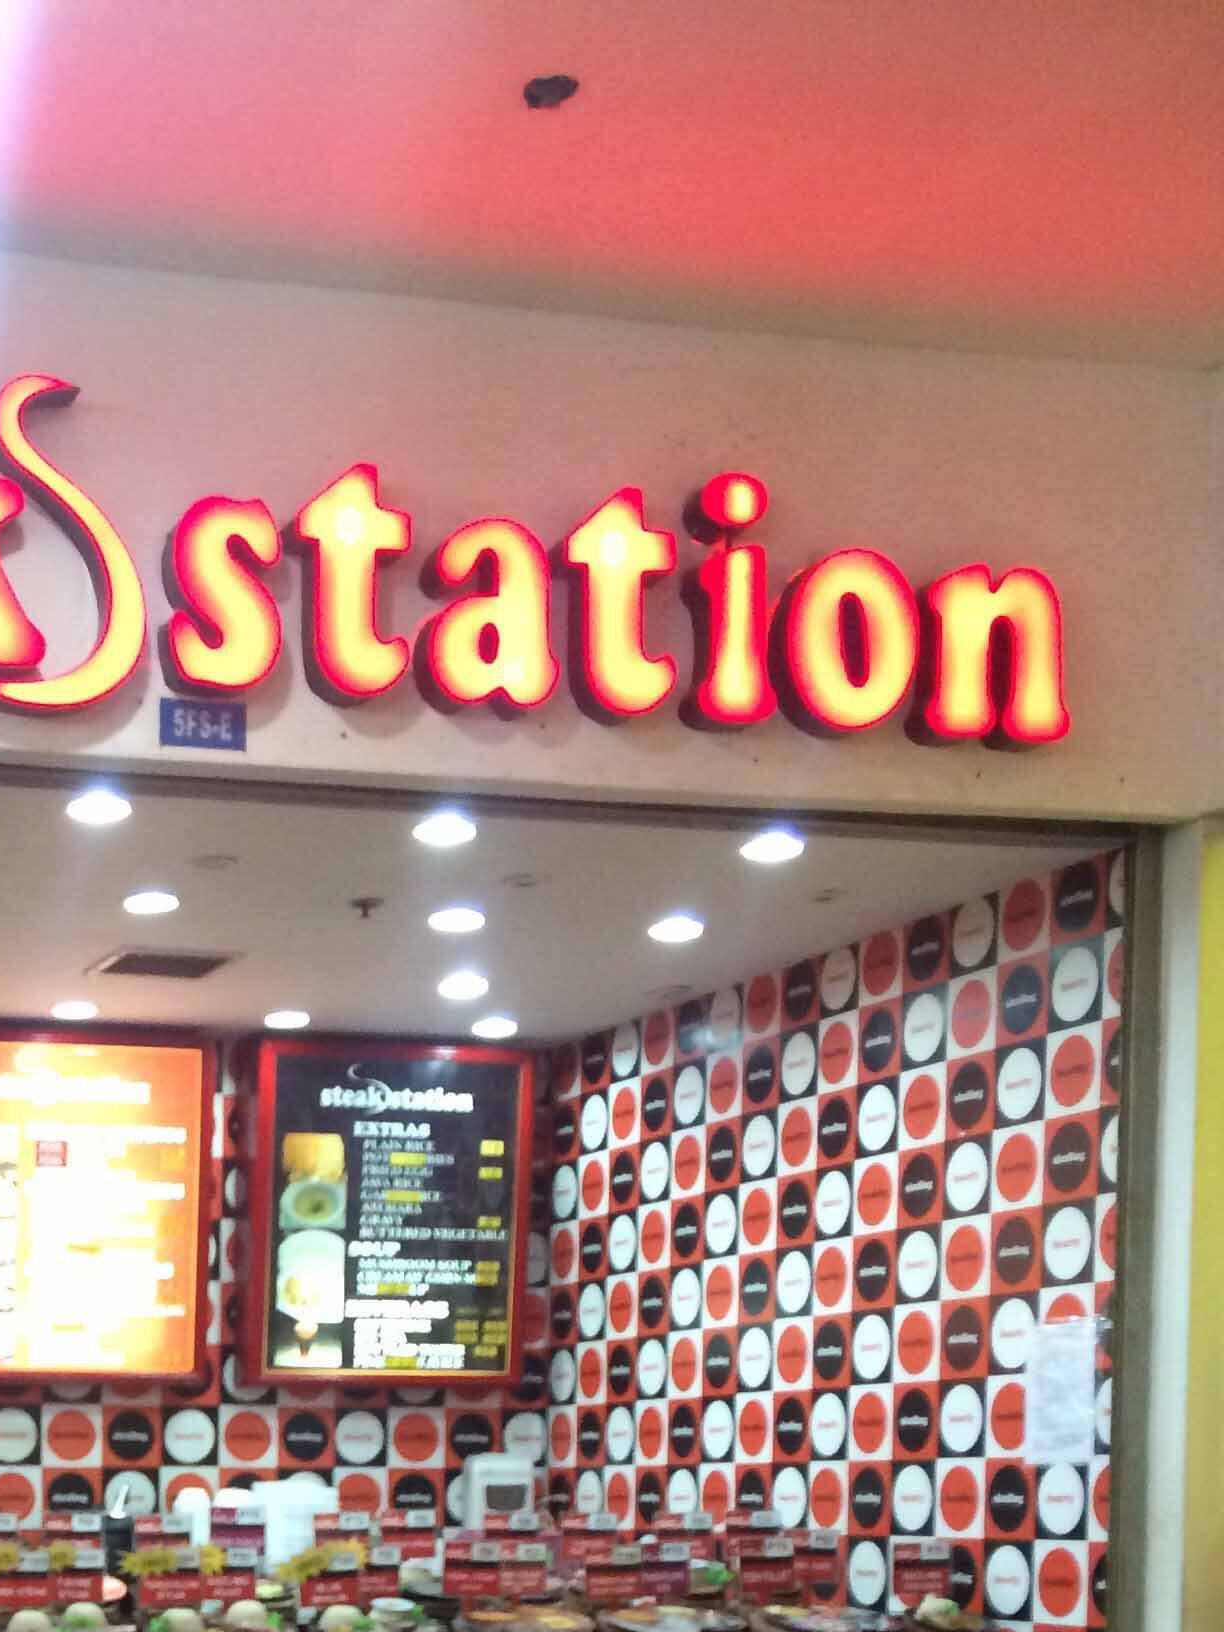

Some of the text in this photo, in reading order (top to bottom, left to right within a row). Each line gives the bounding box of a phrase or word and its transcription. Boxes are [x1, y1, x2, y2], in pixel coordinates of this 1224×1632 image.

[169, 463, 1070, 744] station
[320, 1085, 384, 1109] steak
[353, 1121, 431, 1138] EXTRAS
